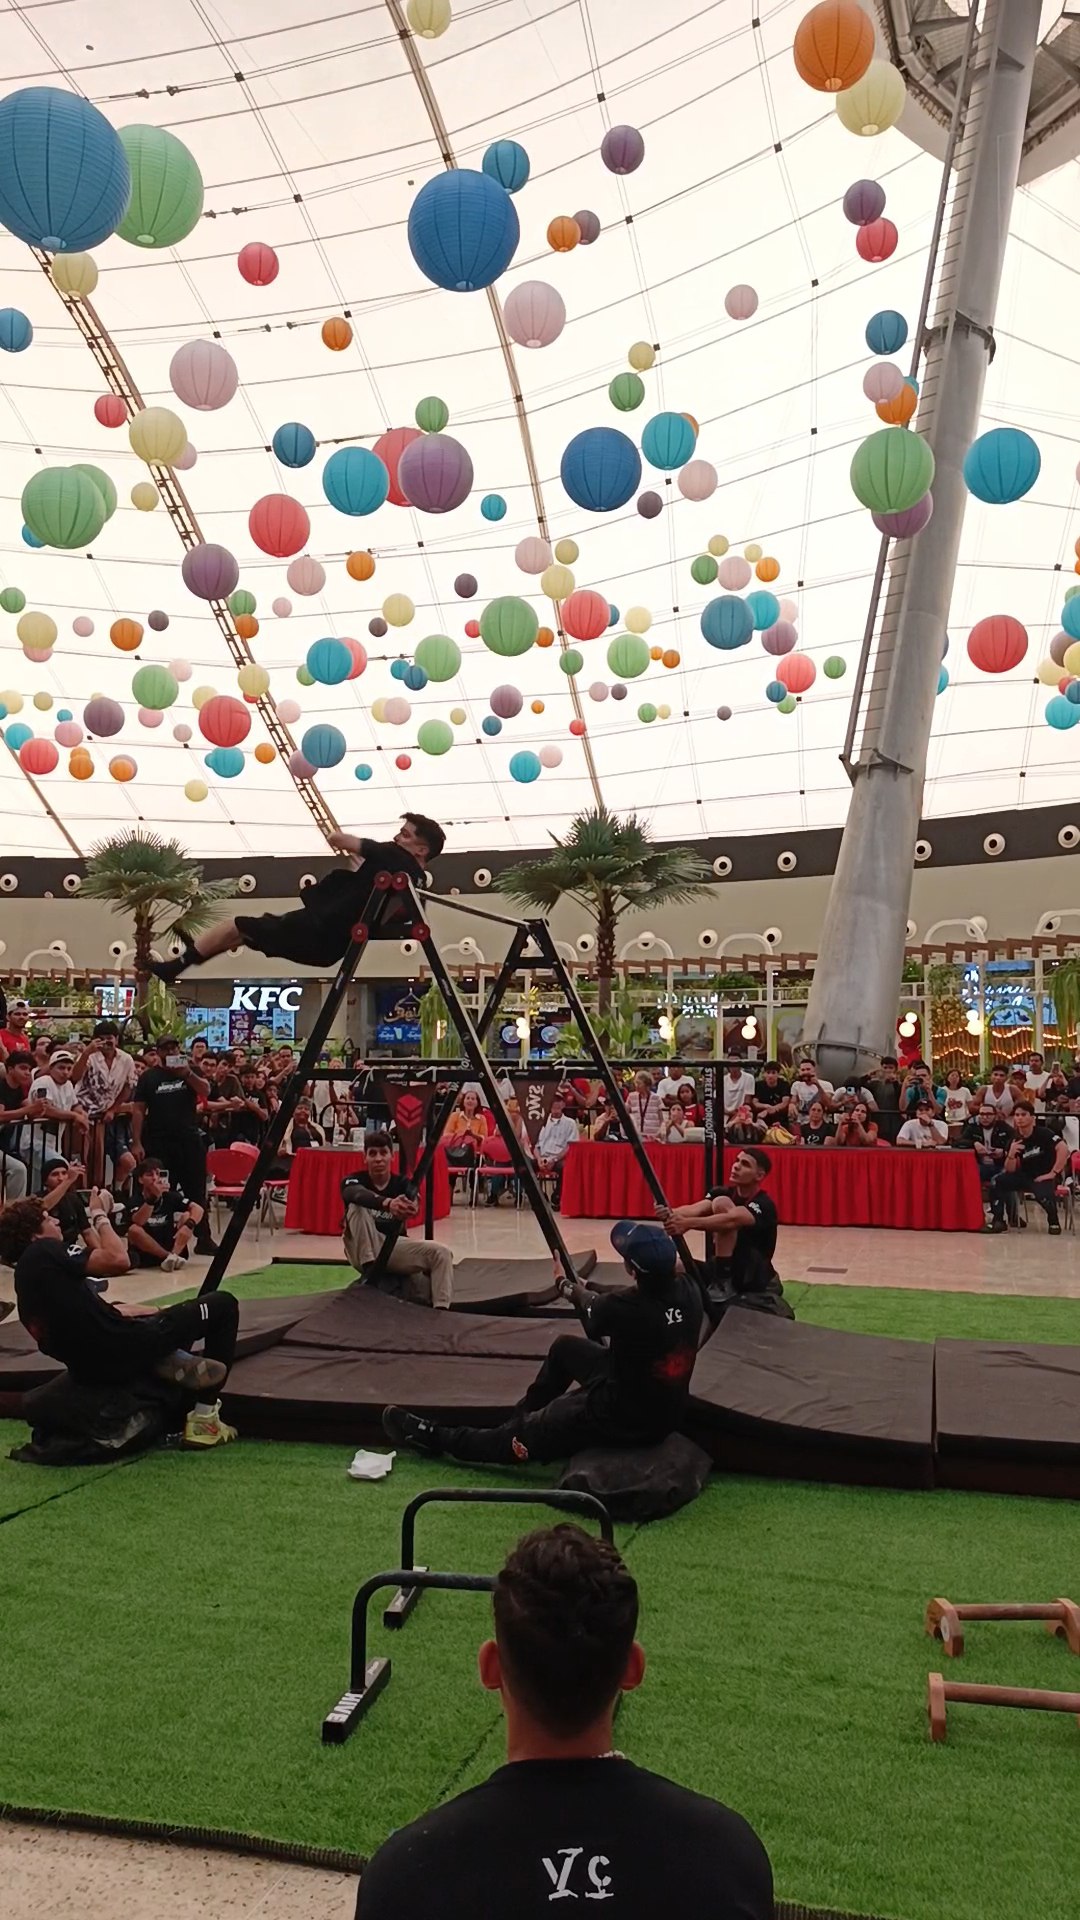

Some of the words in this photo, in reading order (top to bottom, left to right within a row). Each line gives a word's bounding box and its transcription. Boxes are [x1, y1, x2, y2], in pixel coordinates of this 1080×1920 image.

[229, 986, 303, 1011] KFC
[704, 1067, 713, 1098] STREET
[528, 1085, 542, 1120] SWC
[704, 1100, 714, 1139] WORKOUT
